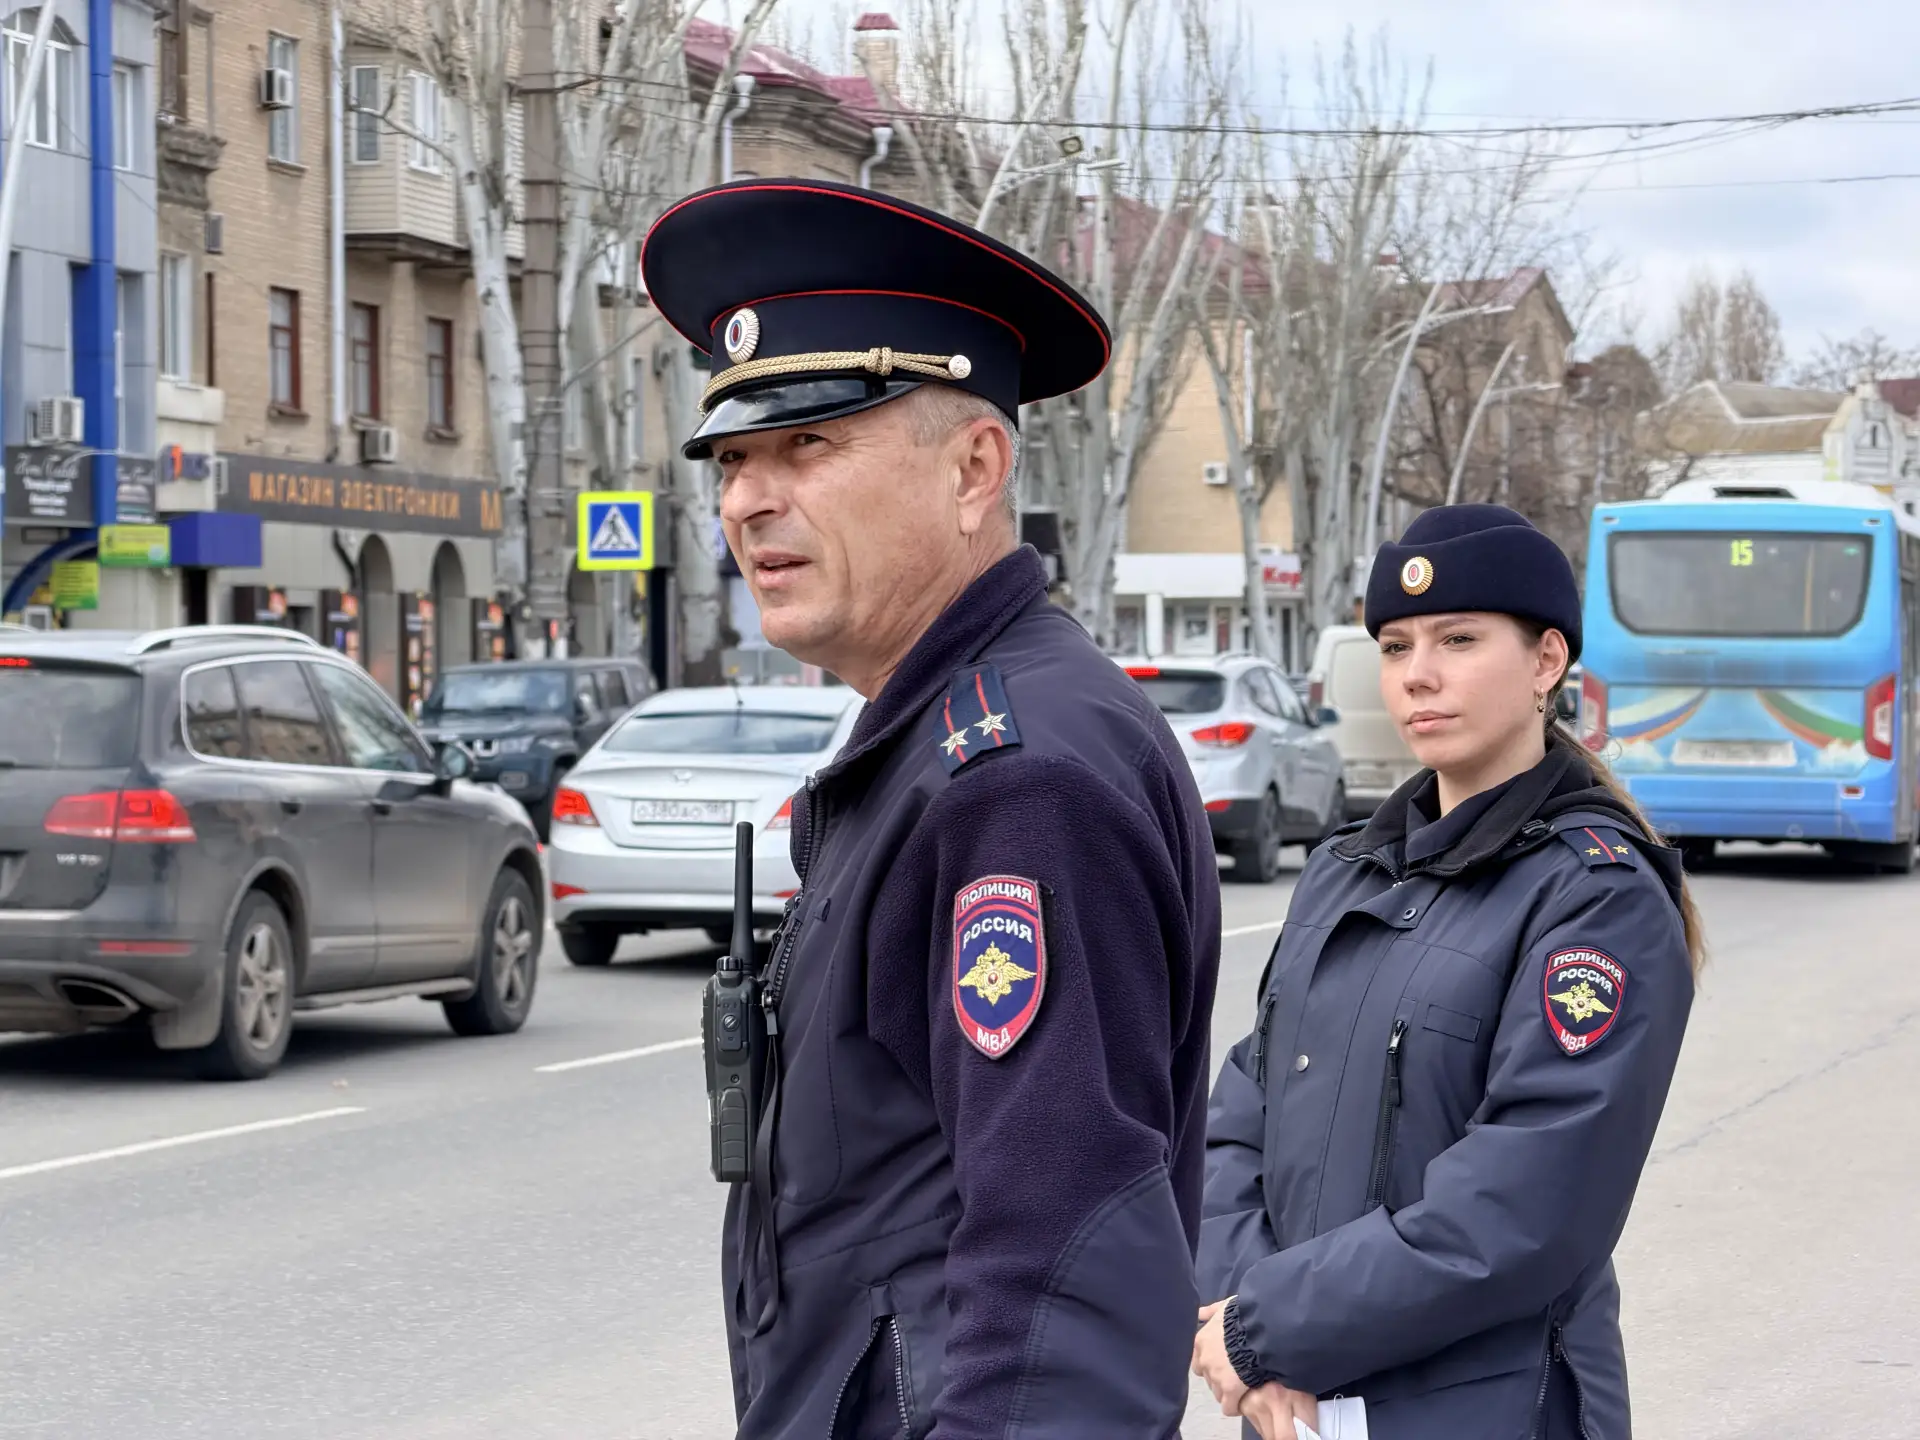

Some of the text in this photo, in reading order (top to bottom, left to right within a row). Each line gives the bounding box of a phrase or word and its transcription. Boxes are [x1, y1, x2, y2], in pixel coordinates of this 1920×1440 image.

[249, 471, 335, 508] МАГАЗИН
[340, 479, 461, 520] ЭЛЕКТРОНИКИ
[1731, 539, 1753, 566] 15
[960, 882, 1033, 911] ПОЛИЦИЯ
[962, 916, 1033, 951] РОССИЯ
[1553, 951, 1623, 983] ПОЛИЦИЯ
[1557, 967, 1613, 996] РОССИЯ
[976, 1026, 1011, 1051] МВД
[1560, 1028, 1588, 1051] МВД
